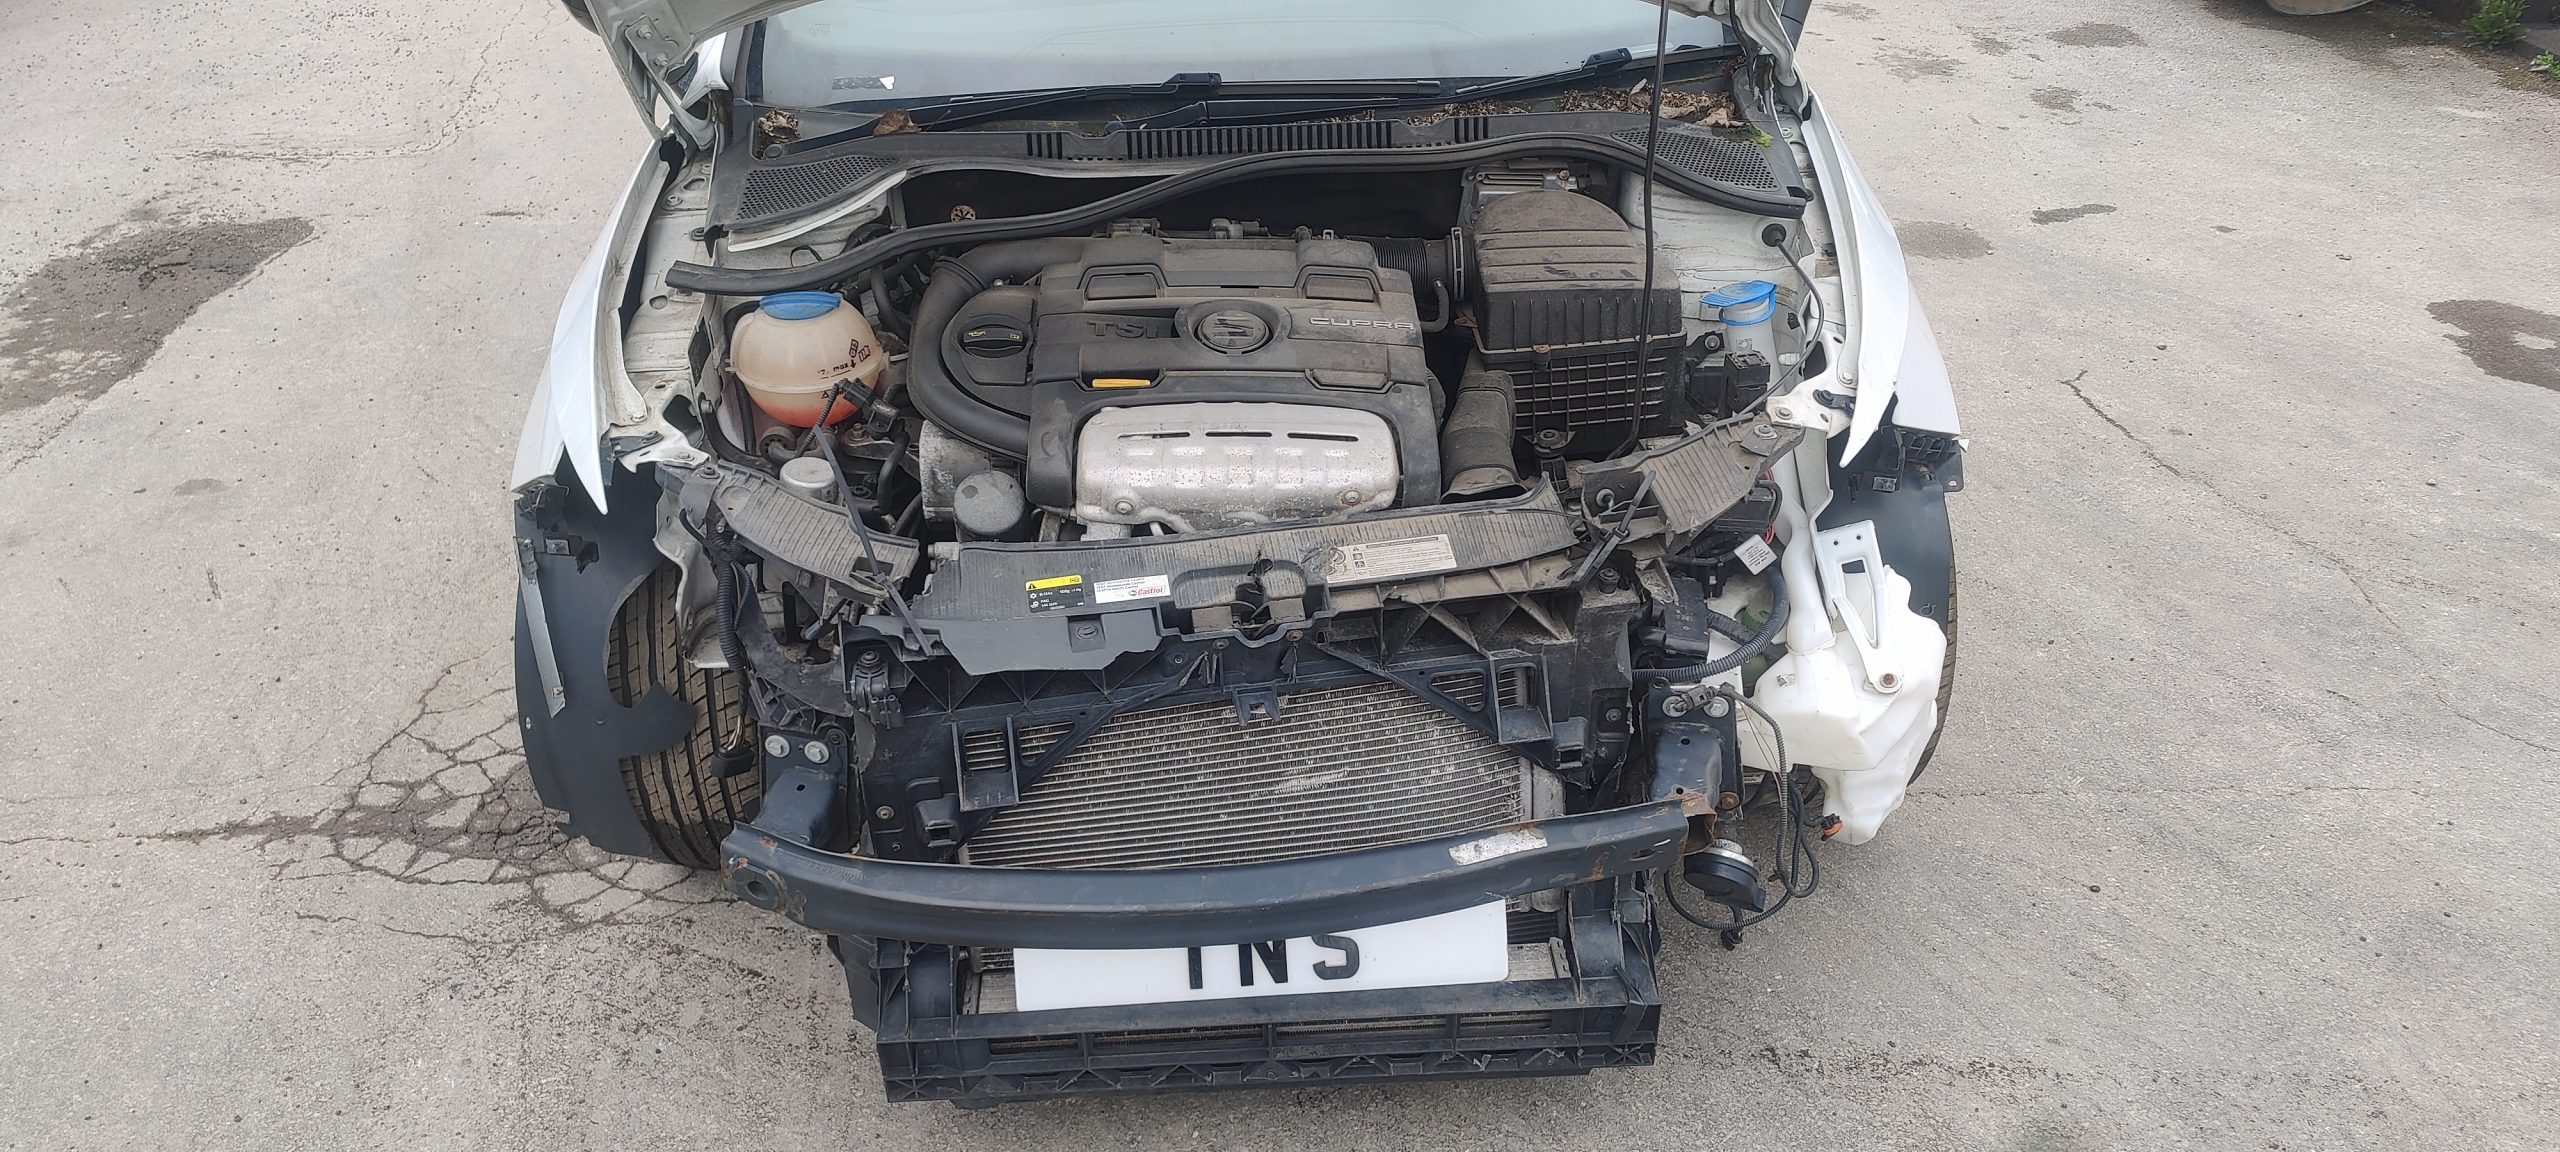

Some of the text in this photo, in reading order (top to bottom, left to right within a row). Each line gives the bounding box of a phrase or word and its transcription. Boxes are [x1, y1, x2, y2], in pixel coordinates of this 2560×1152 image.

[1087, 318, 1160, 339] TSI
[1309, 317, 1414, 330] CUPRA
[833, 362, 849, 372] max
[1137, 586, 1163, 596] Castrol
